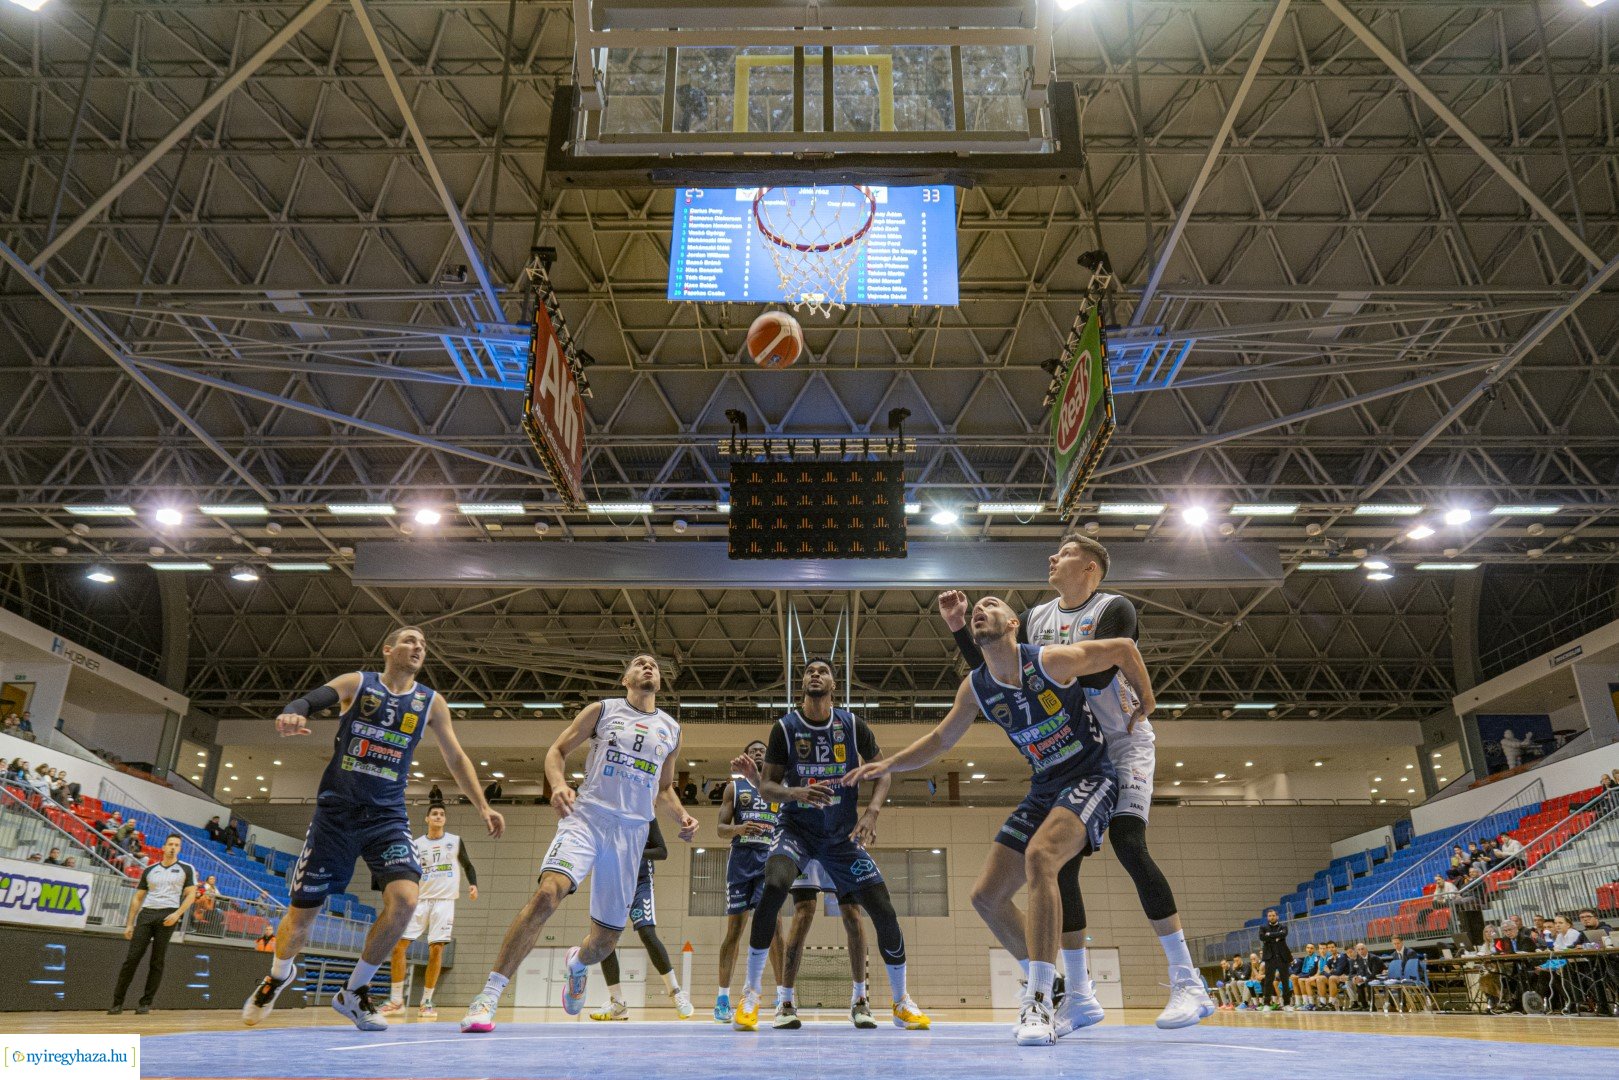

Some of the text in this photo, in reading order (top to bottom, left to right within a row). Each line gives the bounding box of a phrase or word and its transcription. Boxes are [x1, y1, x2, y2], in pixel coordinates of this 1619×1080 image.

[922, 188, 940, 202] 33
[380, 708, 396, 726] 3
[1018, 702, 1032, 726] 7
[632, 734, 644, 752] 8
[815, 745, 830, 763] 12
